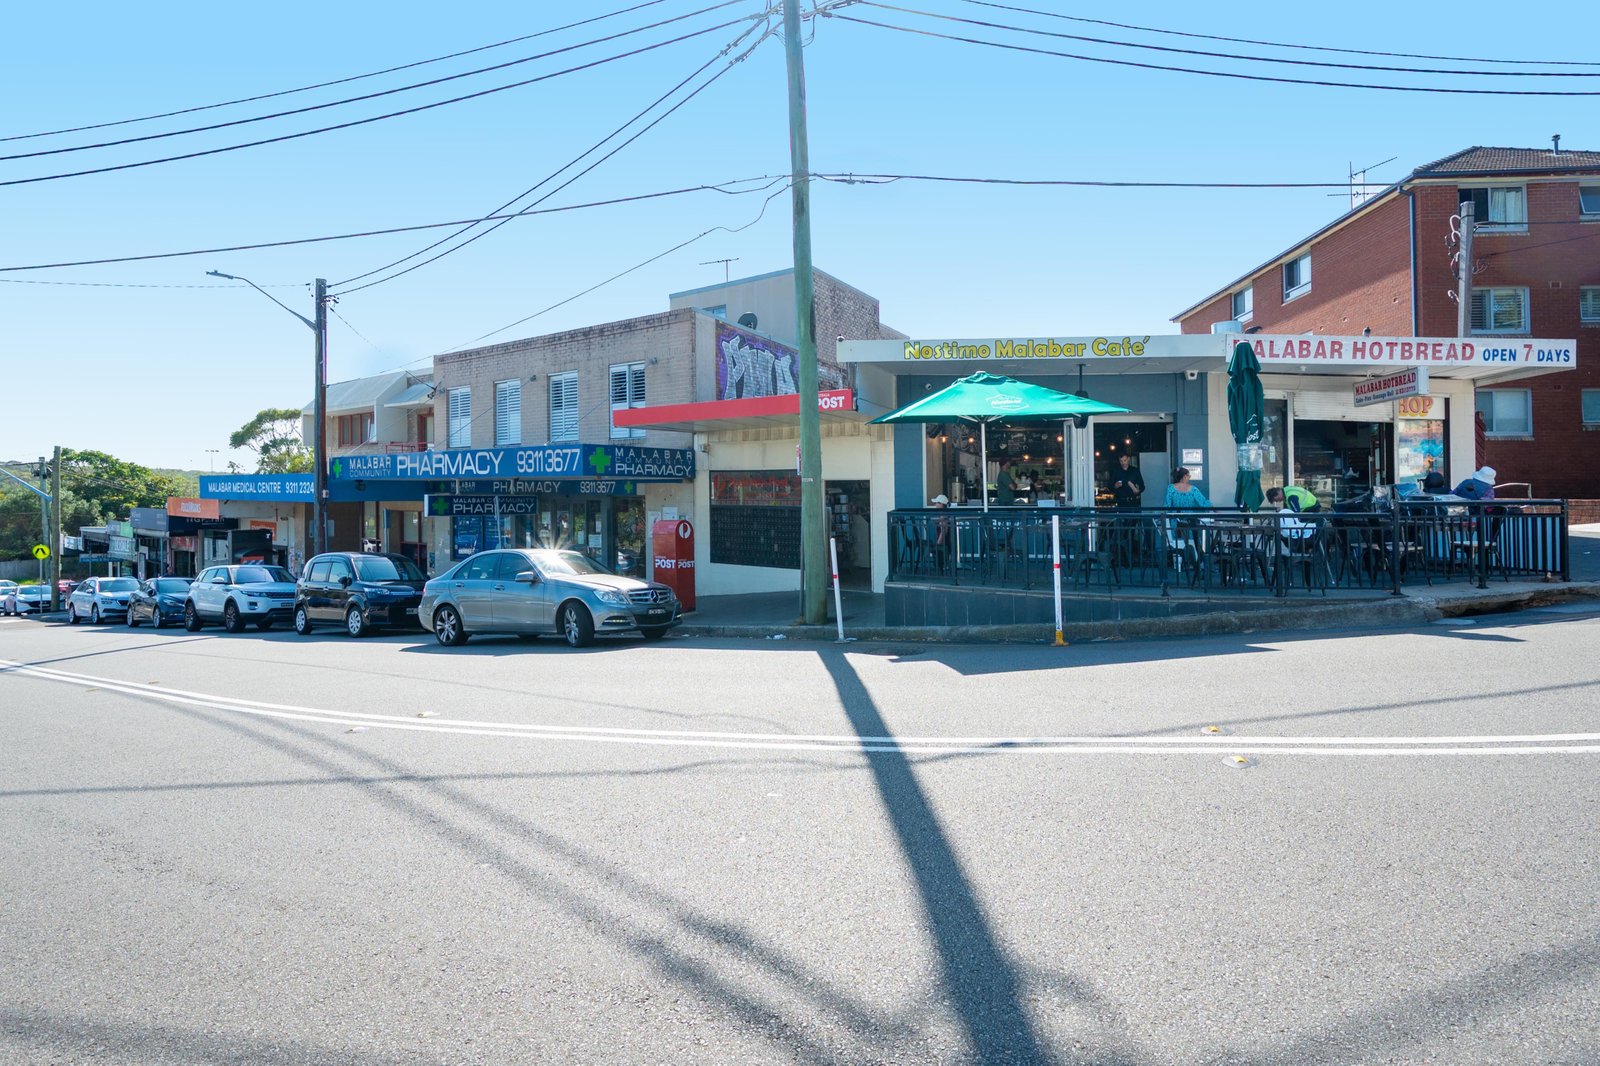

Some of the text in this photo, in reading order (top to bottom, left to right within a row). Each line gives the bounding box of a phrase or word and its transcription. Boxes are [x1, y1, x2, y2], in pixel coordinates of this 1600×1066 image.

[903, 341, 991, 360] Nostimo
[994, 338, 1087, 358] Malabar
[1233, 339, 1571, 363] ALABAR HOTBREAD OPEN 7 DAYS
[1355, 372, 1417, 396] MALABAR HOTBREAD
[615, 447, 693, 459] MALABAR
[349, 456, 392, 470] MALABAR
[396, 451, 504, 477] PHARMACY
[615, 456, 692, 465] COMMUNITY
[349, 467, 392, 478] COMMUNITY
[615, 463, 692, 477] PHARMACY
[208, 482, 233, 493] MALABAR
[232, 482, 257, 493] MEDICAL
[257, 482, 281, 494] CENTRE
[285, 482, 299, 494] 9311
[493, 480, 561, 493] PHARMACY
[453, 502, 534, 514] PHARMACY
[655, 559, 676, 569] POST
[677, 560, 695, 569] POST
